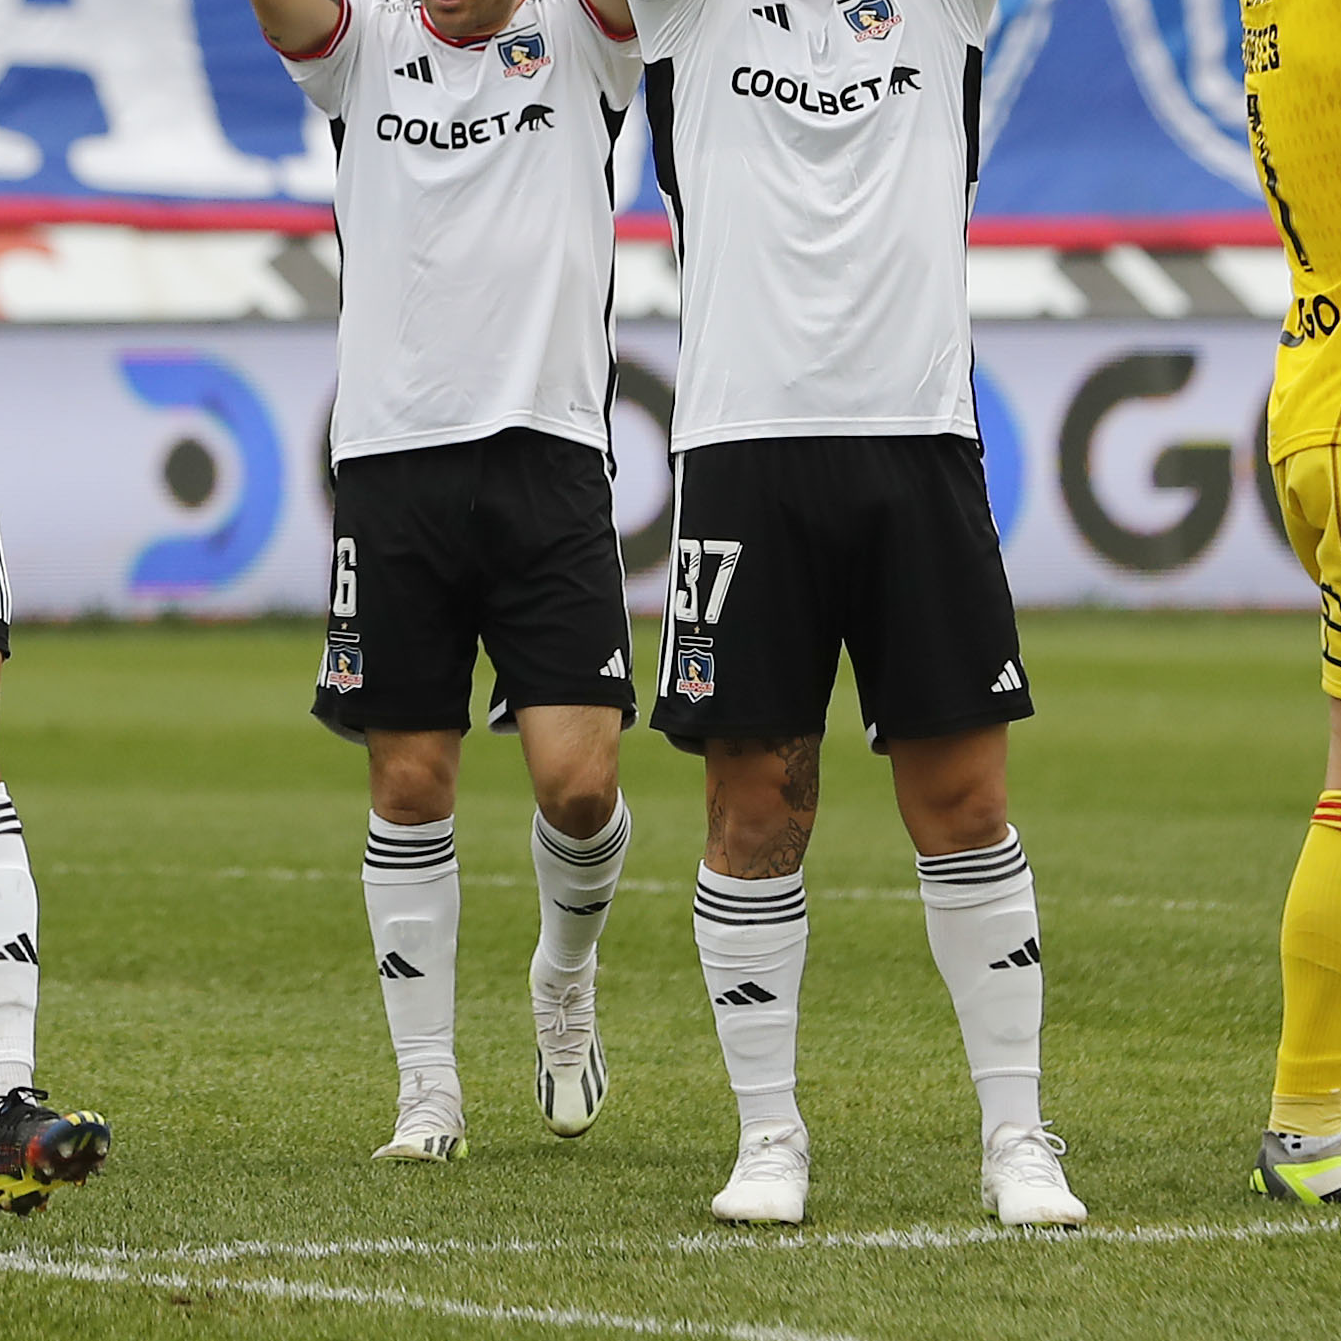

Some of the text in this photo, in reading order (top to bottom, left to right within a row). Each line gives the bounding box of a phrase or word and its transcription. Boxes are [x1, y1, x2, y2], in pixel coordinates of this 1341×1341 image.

[732, 66, 882, 115] COOLBET
[333, 537, 357, 617] 6
[675, 538, 743, 624] 37
